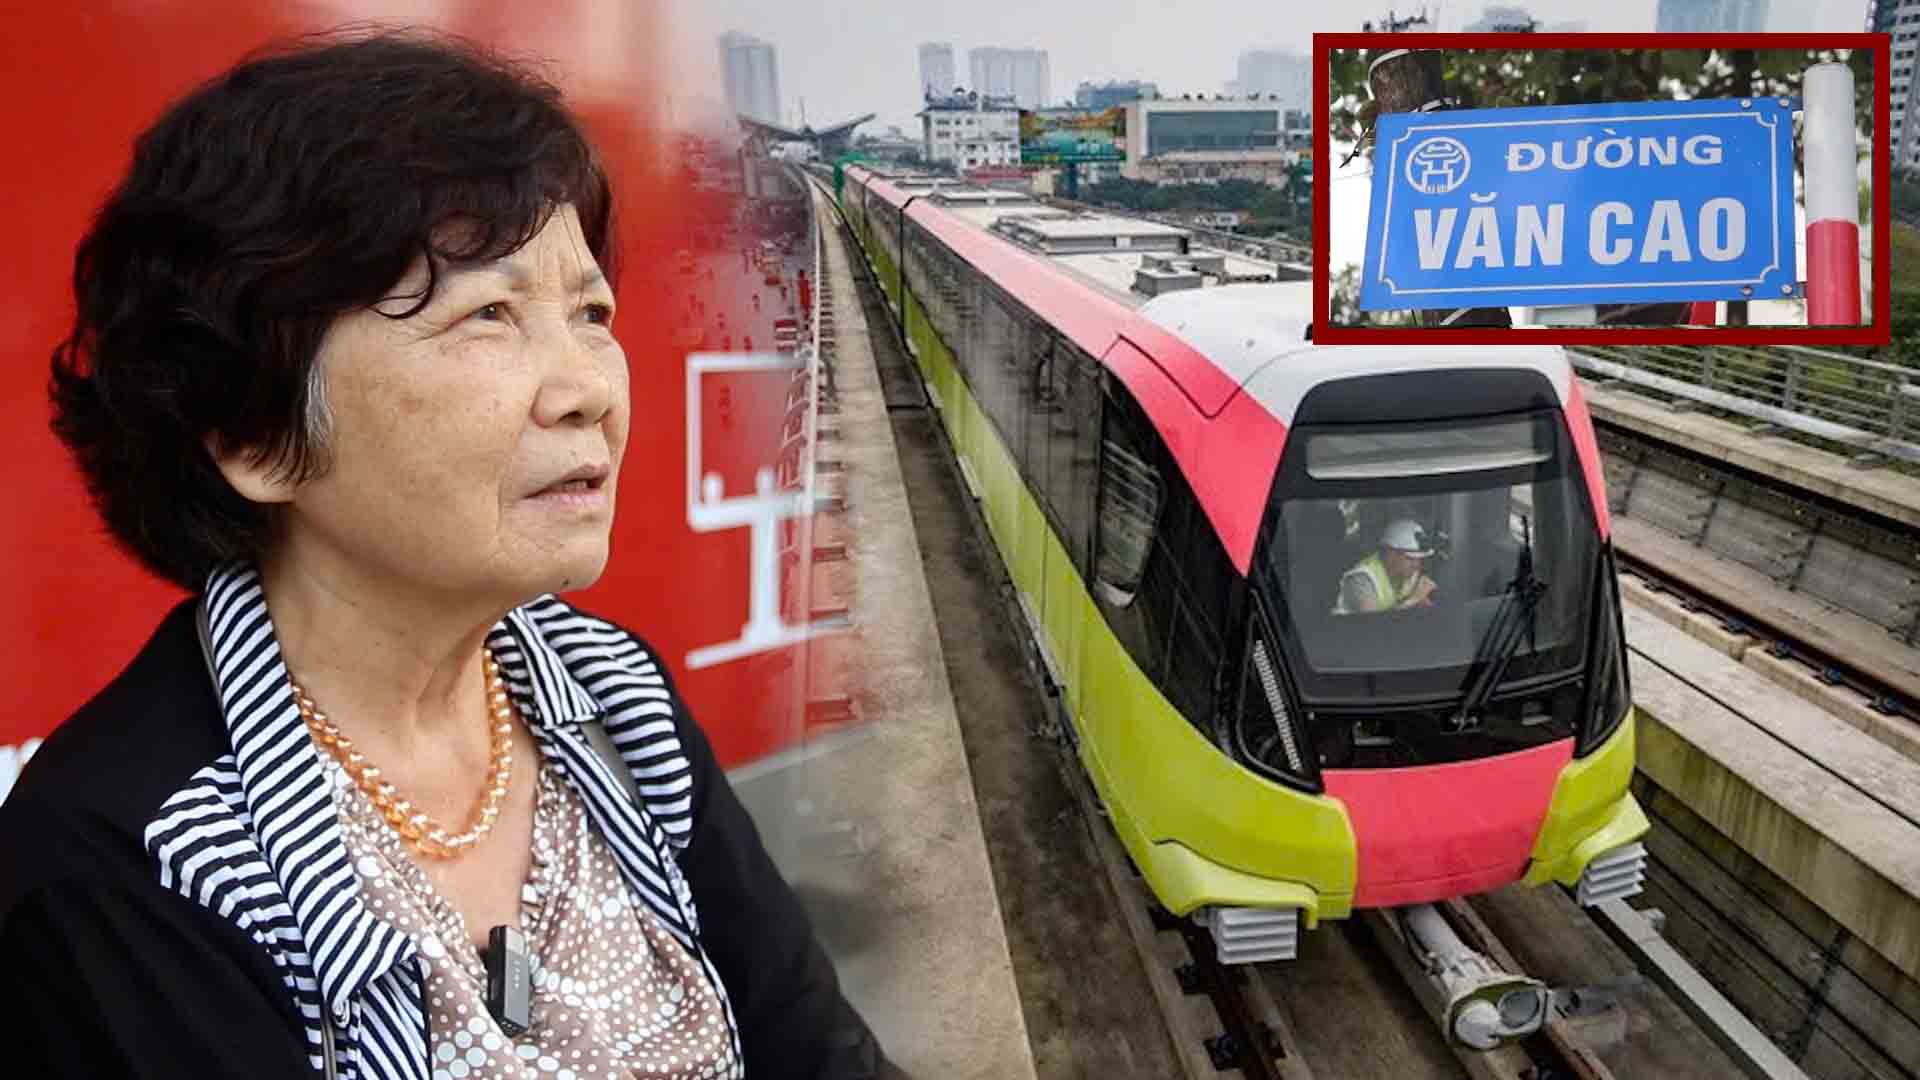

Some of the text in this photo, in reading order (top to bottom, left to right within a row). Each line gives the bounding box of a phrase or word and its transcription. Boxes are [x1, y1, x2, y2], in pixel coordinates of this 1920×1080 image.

[1505, 129, 1723, 173] ĐƯỜNG
[1413, 191, 1747, 271] VĂN CAO
